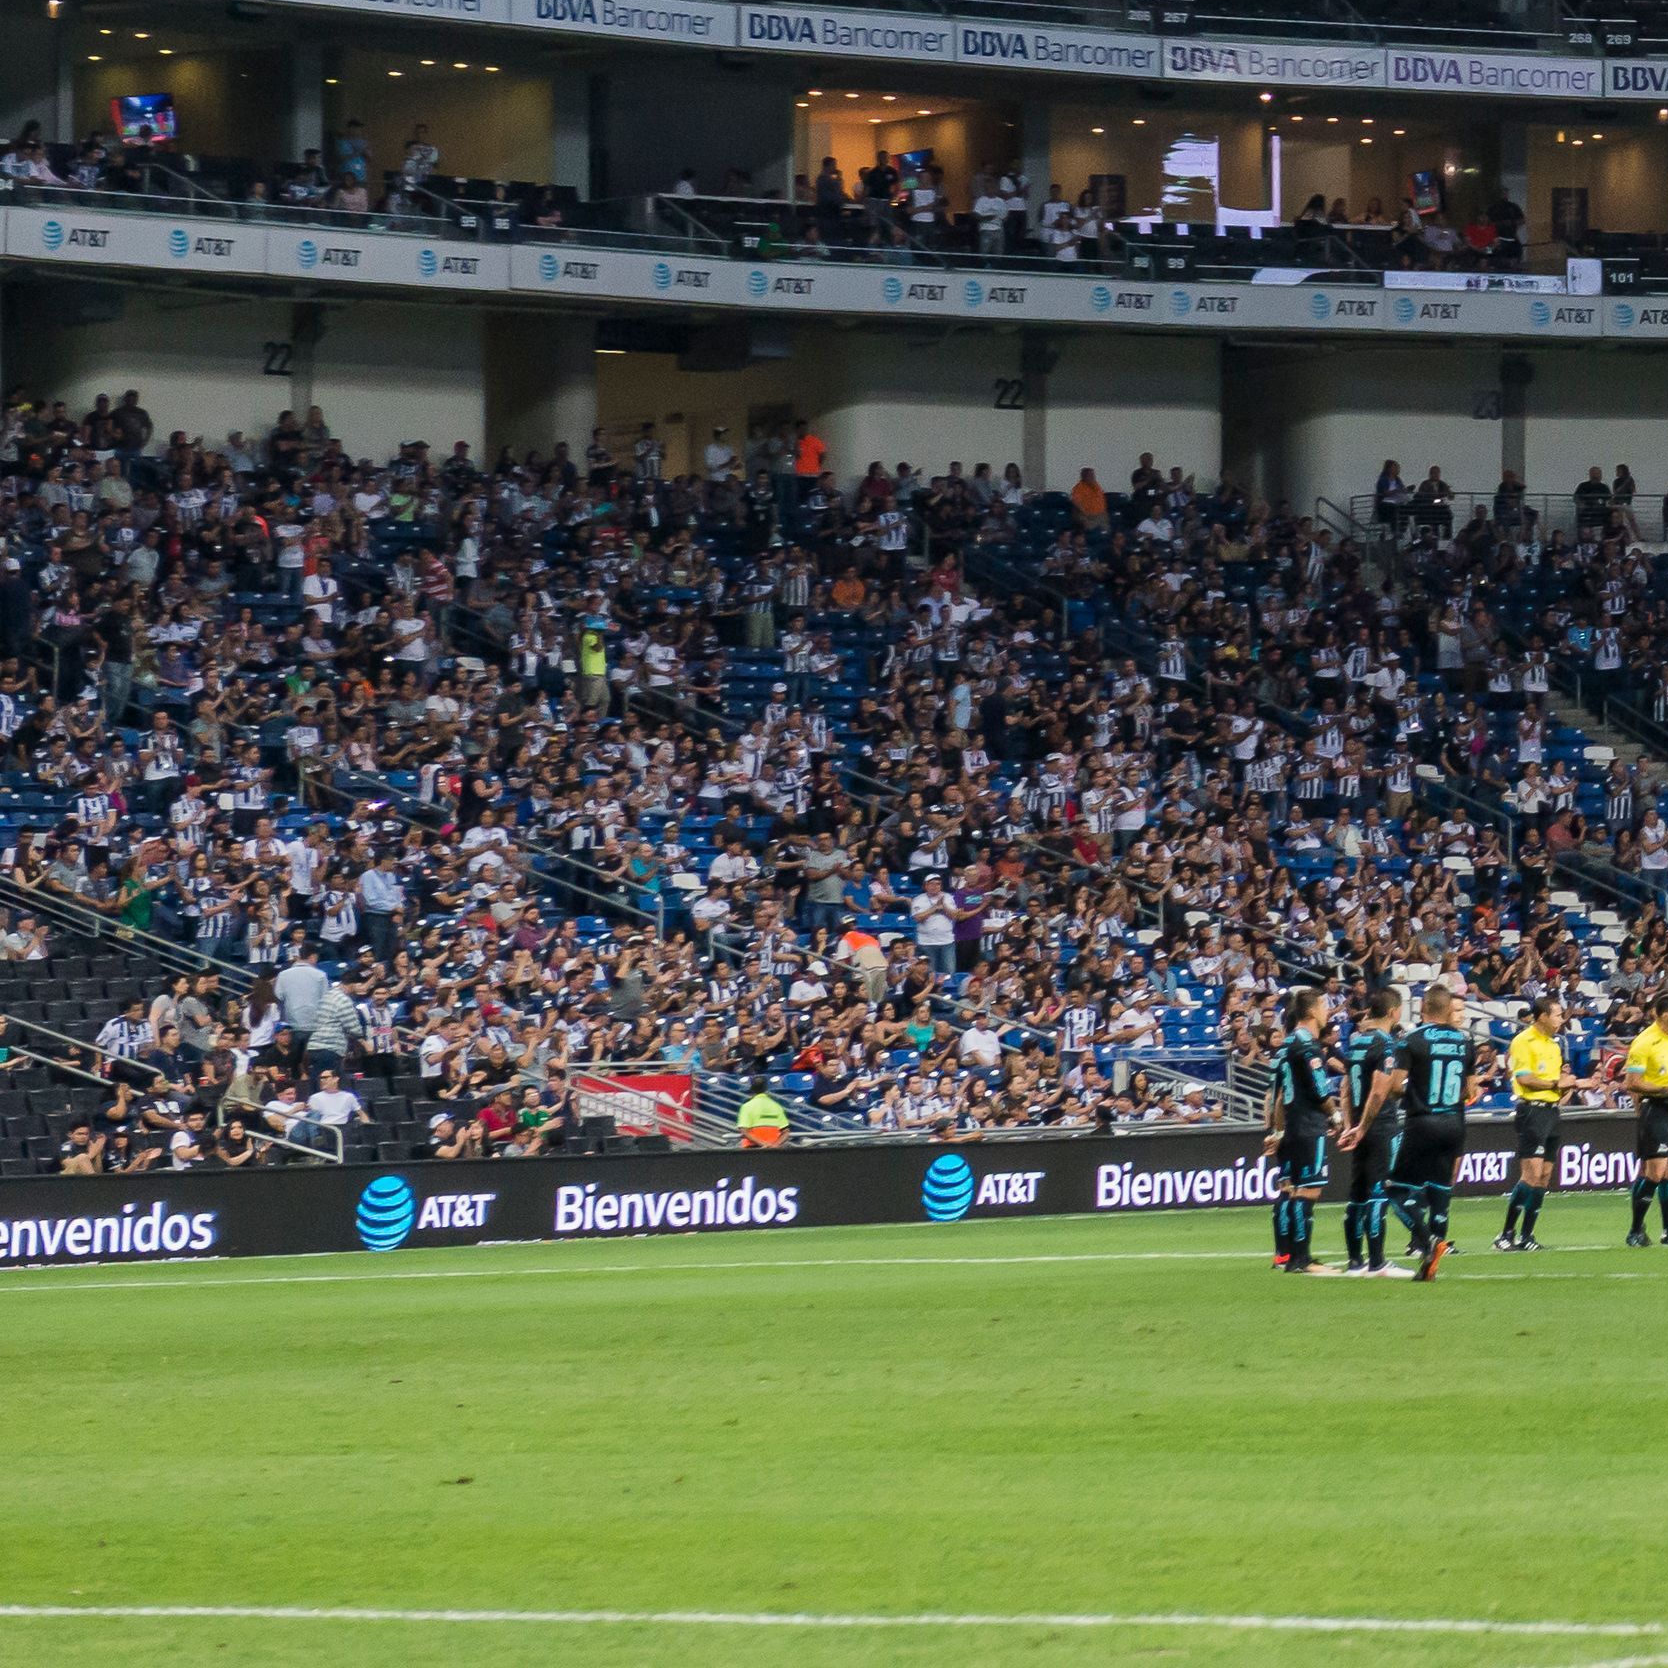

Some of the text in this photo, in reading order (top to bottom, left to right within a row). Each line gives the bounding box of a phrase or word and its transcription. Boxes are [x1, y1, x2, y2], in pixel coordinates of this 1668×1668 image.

[962, 29, 1156, 69] BBVA Bancomer
[67, 228, 111, 248] AT&T
[987, 286, 1028, 304] AT&T
[1335, 299, 1378, 317] AT&T
[264, 342, 293, 376] 22
[994, 379, 1025, 409] 22
[1428, 1060, 1464, 1106] 16
[1456, 1151, 1516, 1183] AT&T
[976, 1171, 1045, 1205] AT&T
[417, 1193, 496, 1230] AT&T
[555, 1177, 799, 1233] Bienvenidos
